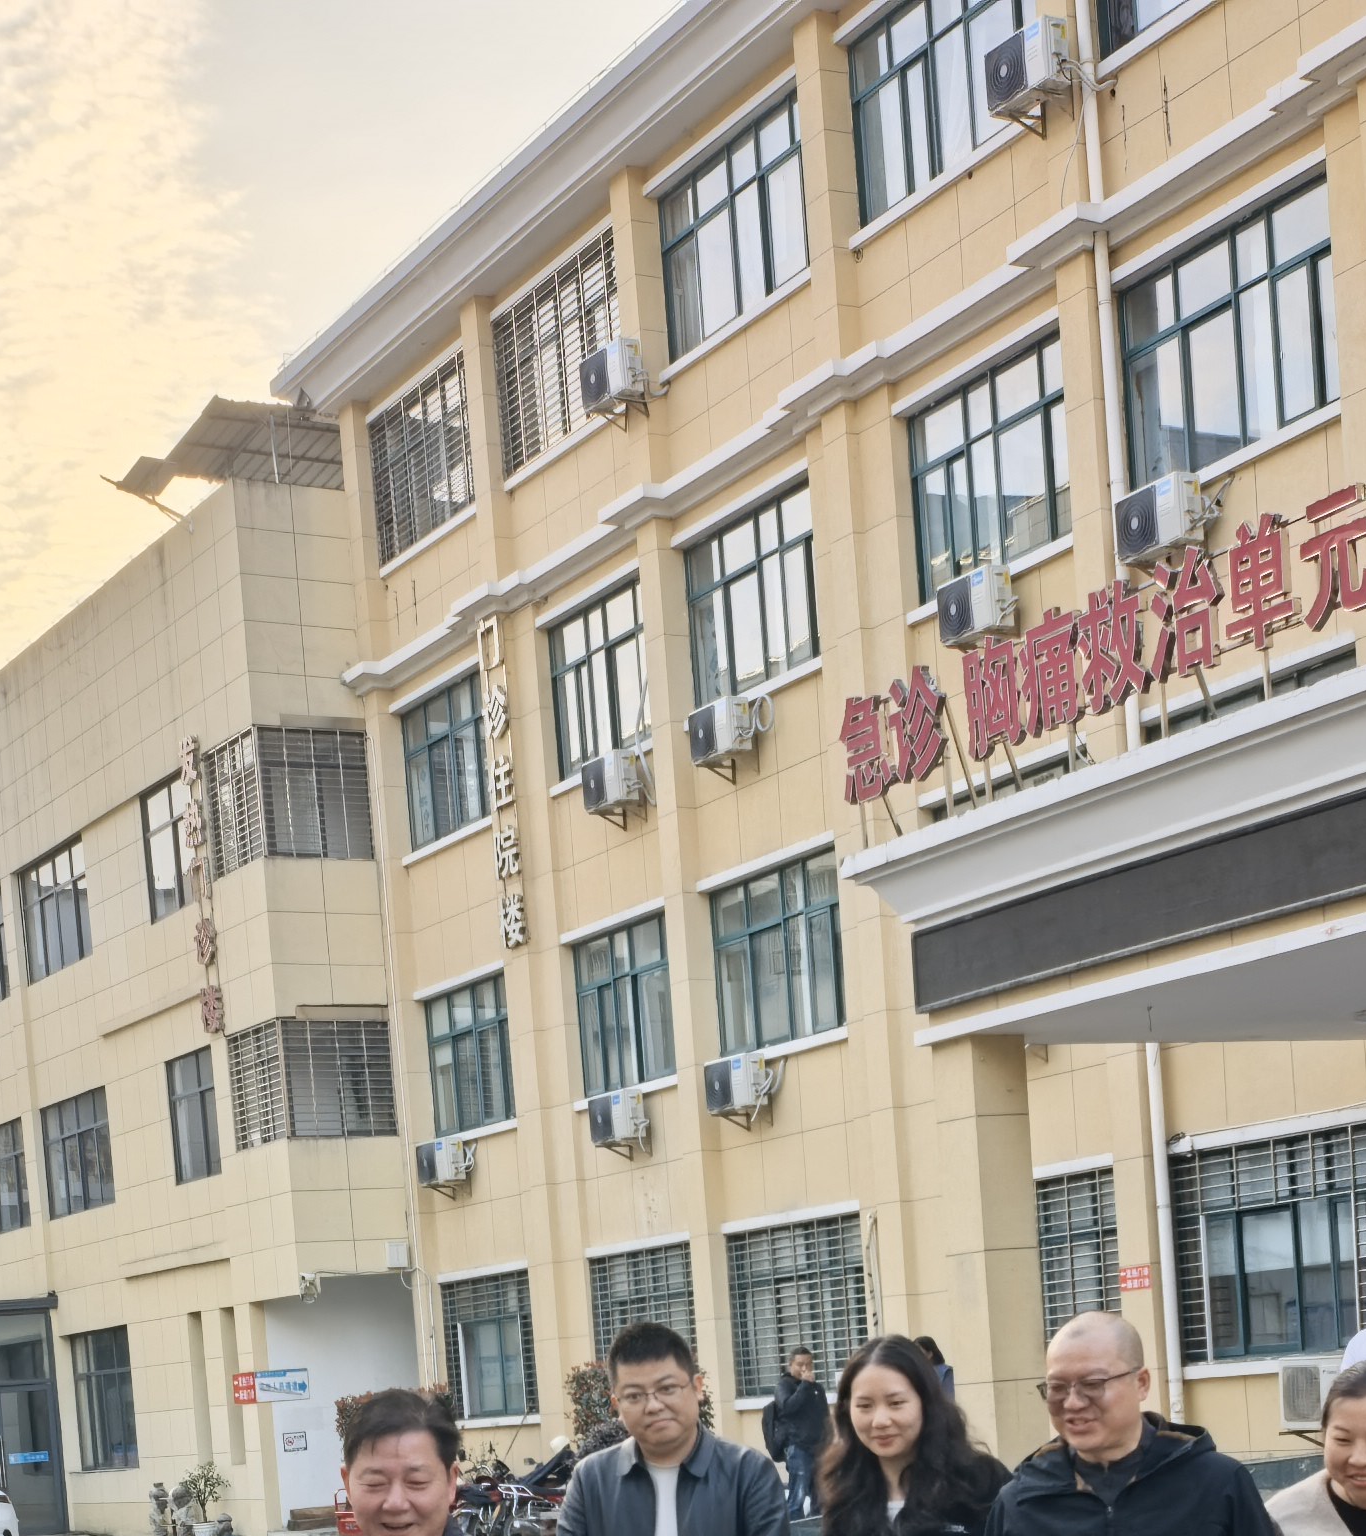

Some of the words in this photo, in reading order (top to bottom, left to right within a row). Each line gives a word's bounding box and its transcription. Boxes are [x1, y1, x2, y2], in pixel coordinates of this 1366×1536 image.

[476, 617, 528, 949] 门诊住院楼
[839, 665, 947, 804] 急诊
